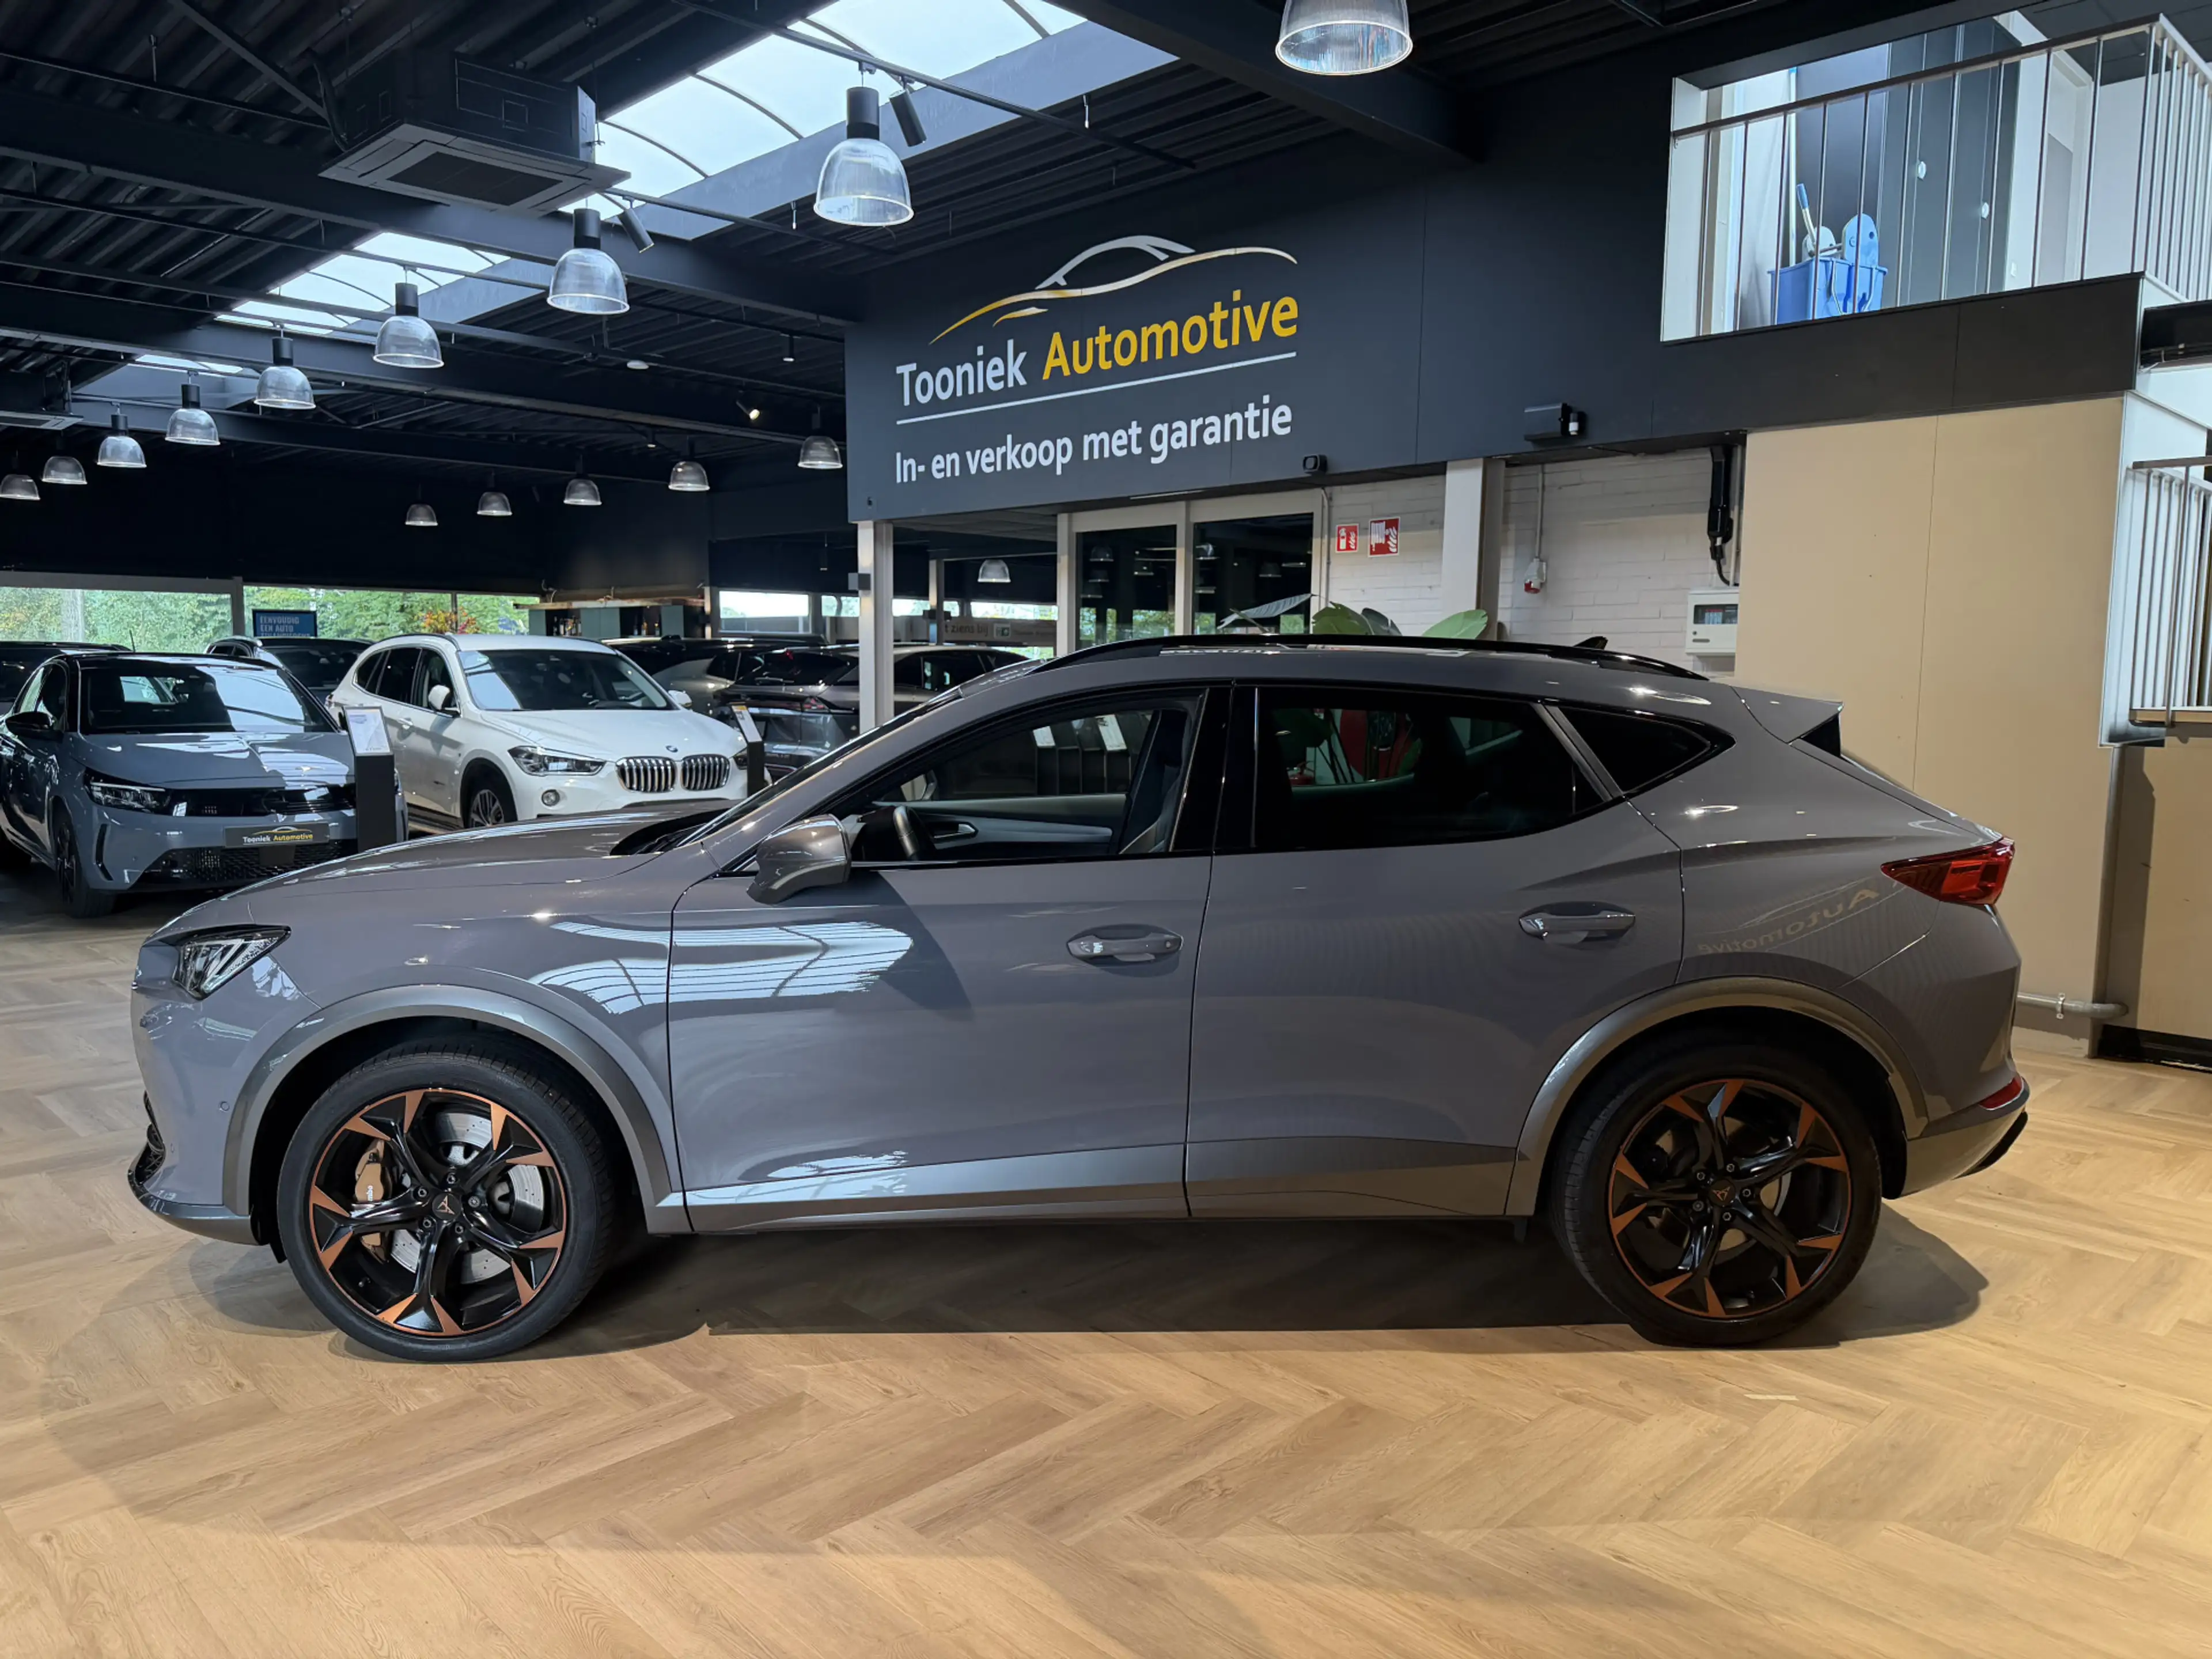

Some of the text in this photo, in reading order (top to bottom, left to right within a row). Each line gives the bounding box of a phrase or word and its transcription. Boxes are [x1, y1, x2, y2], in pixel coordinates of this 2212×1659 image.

[896, 289, 1298, 406] Tooniek Automotive
[896, 395, 1292, 483] In- en verkoop met garantie
[273, 833, 313, 841] Automotive
